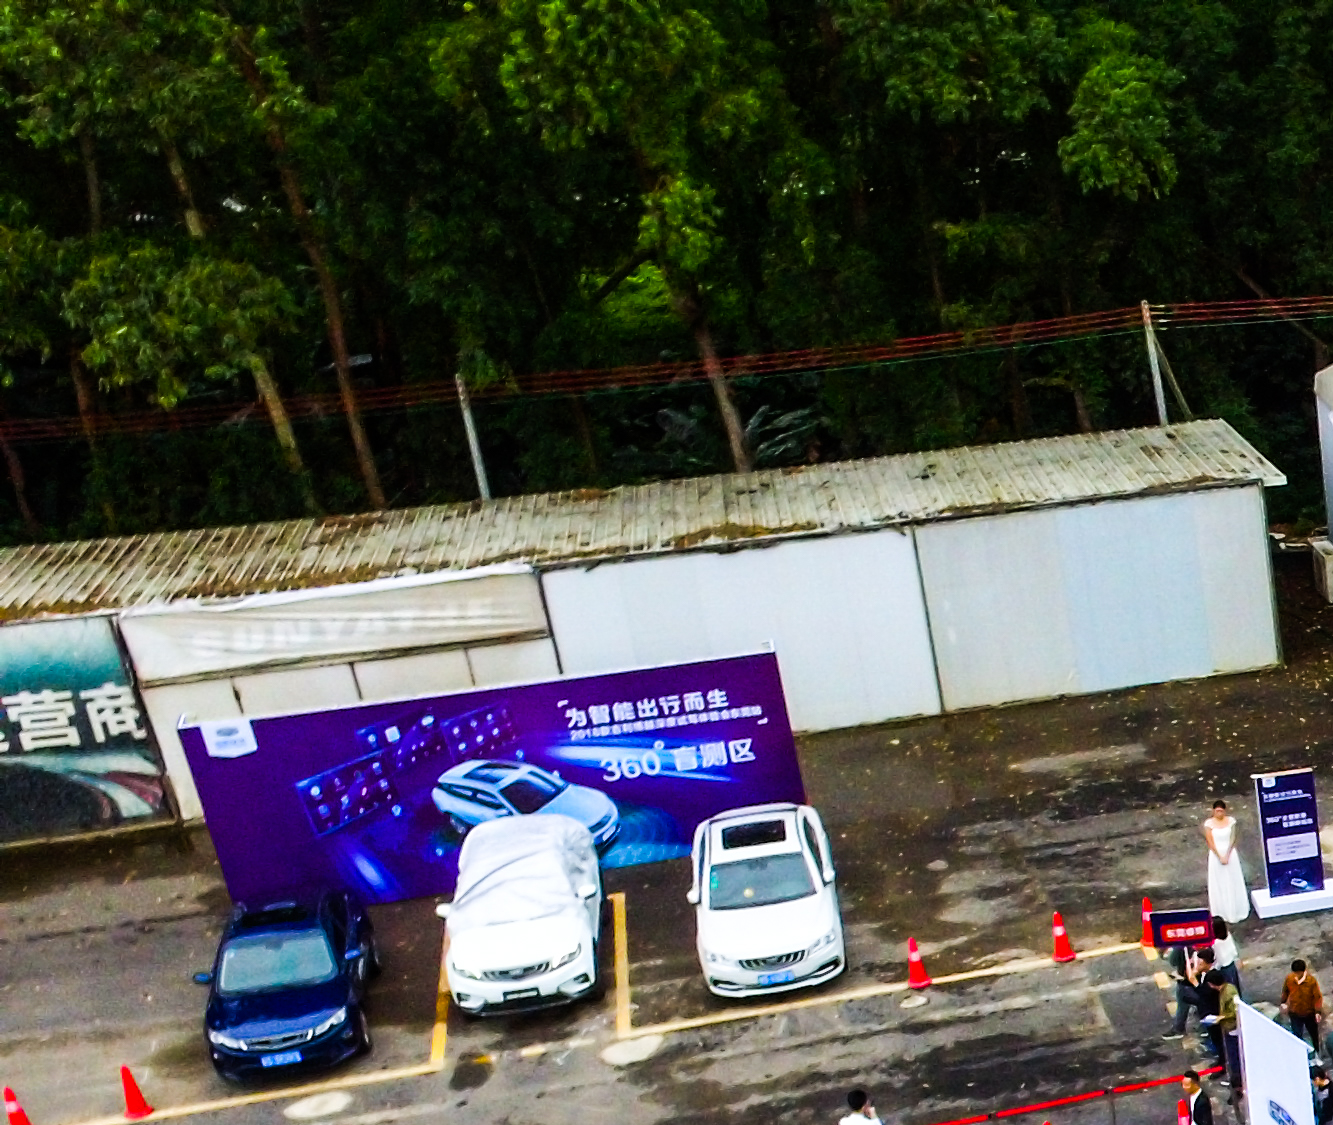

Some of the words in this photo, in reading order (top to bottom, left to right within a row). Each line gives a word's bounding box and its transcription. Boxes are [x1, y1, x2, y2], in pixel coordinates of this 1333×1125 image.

[0, 682, 148, 752] 营商
[565, 688, 729, 728] 为智能出行而生
